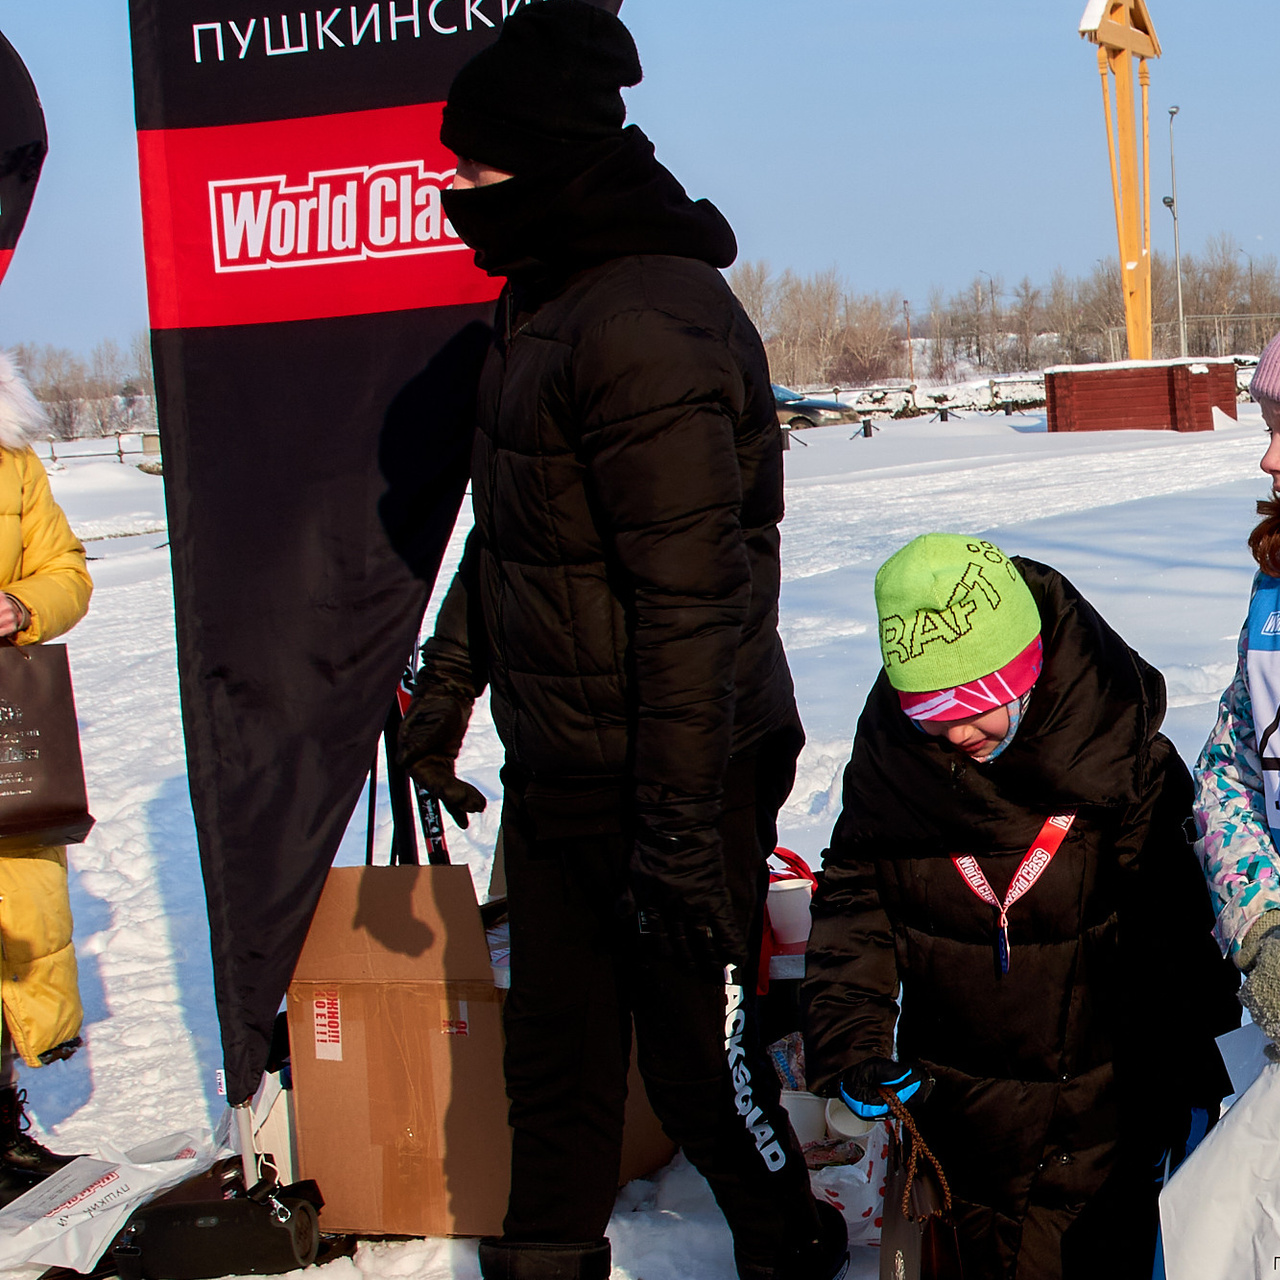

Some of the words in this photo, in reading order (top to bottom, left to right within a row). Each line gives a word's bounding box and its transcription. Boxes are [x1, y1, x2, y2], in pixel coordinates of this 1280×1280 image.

[222, 179, 358, 261] World
[368, 173, 459, 248] Cla
[958, 855, 982, 889] World
[1022, 850, 1049, 881] Class
